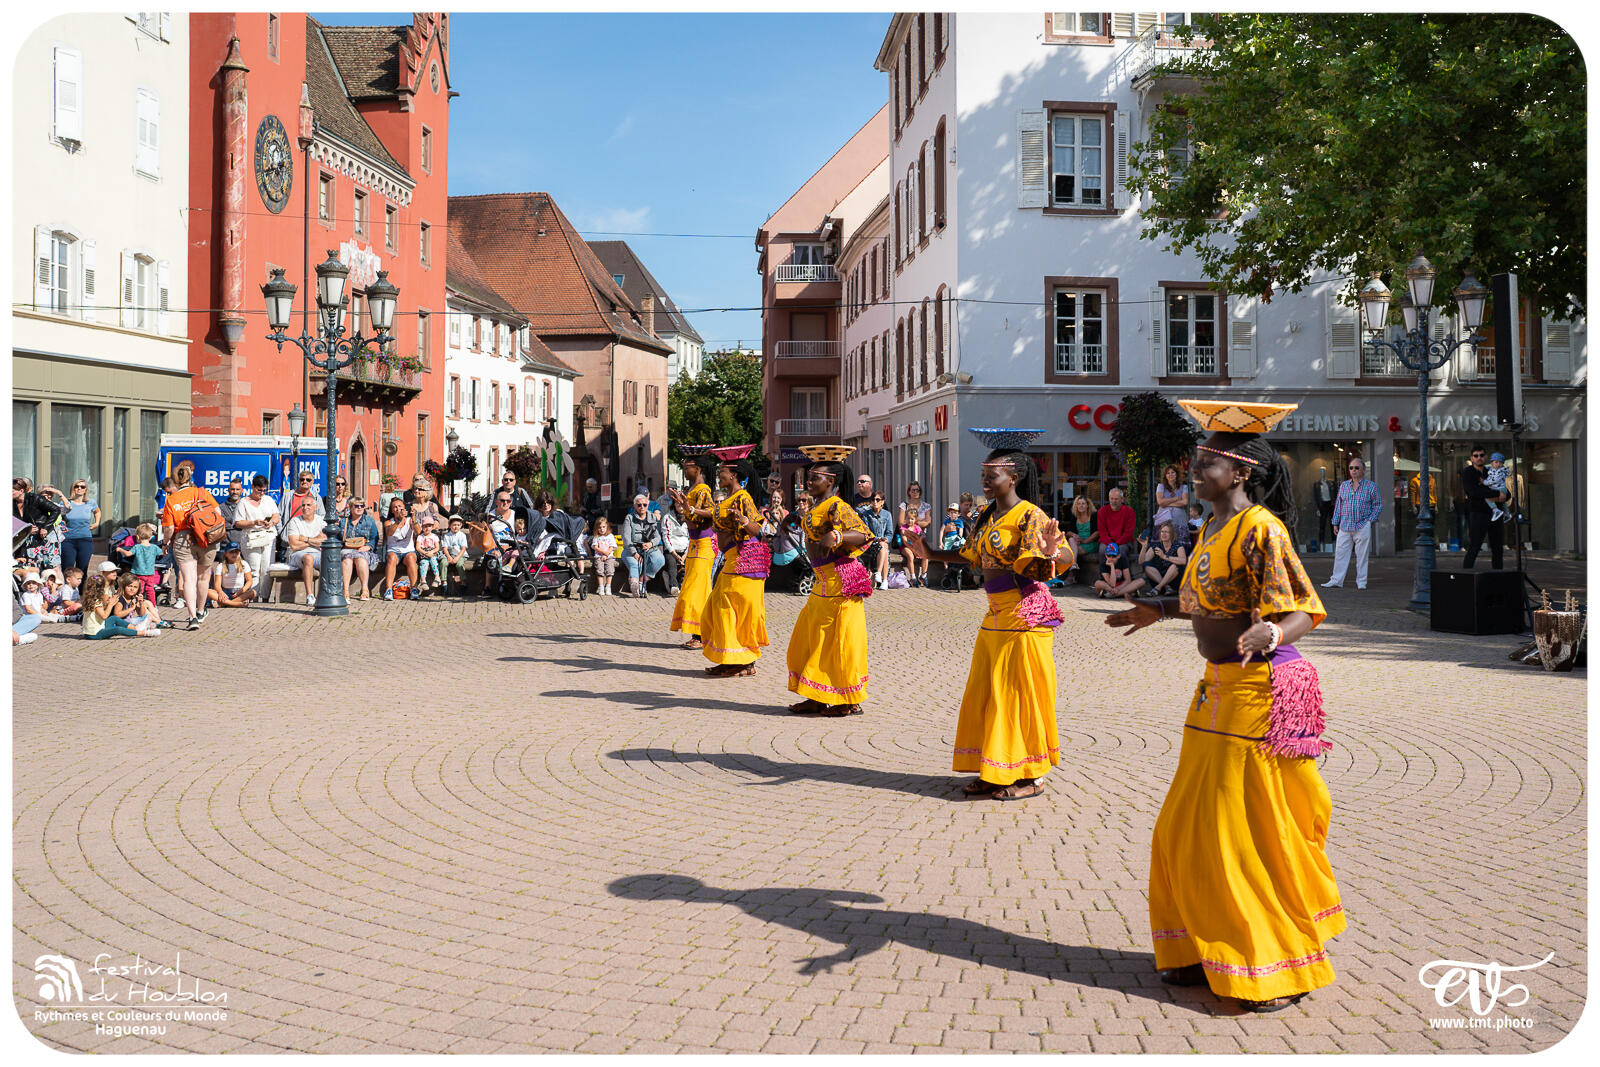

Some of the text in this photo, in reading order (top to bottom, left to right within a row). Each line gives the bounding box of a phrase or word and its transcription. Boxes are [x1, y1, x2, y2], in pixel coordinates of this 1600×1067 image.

[1068, 404, 1126, 431] CC
[1387, 416, 1402, 432] &
[1409, 415, 1540, 432] CHAUSSUS
[206, 470, 257, 486] BECK
